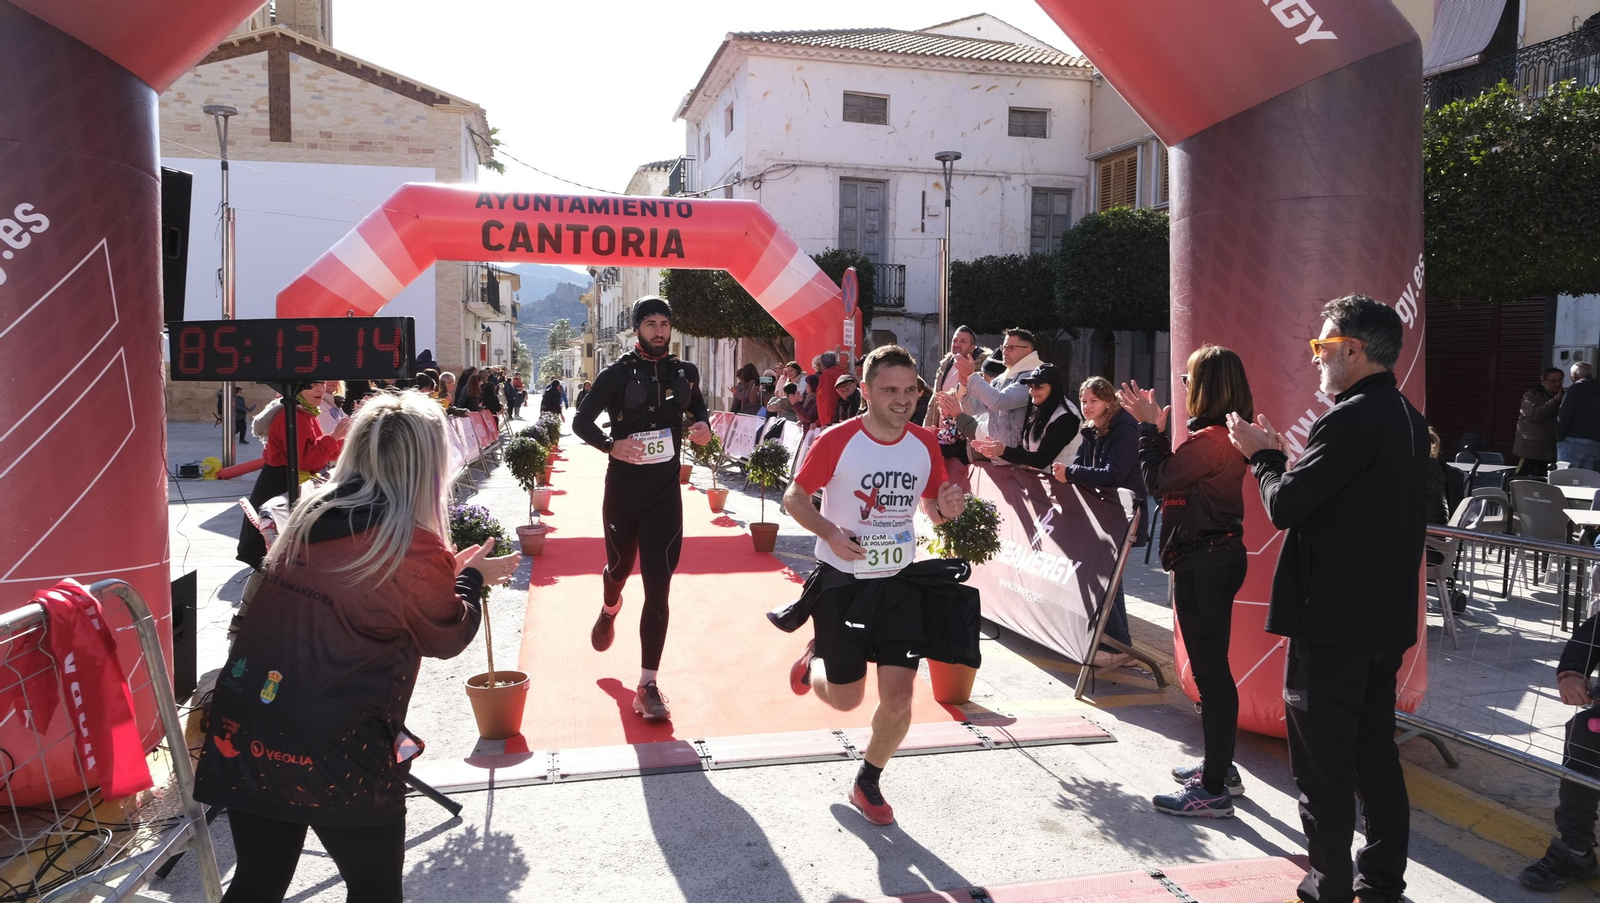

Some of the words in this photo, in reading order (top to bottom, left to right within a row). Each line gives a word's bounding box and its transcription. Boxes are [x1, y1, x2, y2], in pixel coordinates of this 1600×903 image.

[1262, 0, 1338, 45] GY
[475, 191, 693, 219] AYUNTAMIENTO
[482, 219, 685, 259] CANTORIA
[860, 471, 918, 490] correr
[874, 490, 914, 509] jaime
[868, 547, 903, 566] 310
[265, 748, 314, 766] VEOLIA
